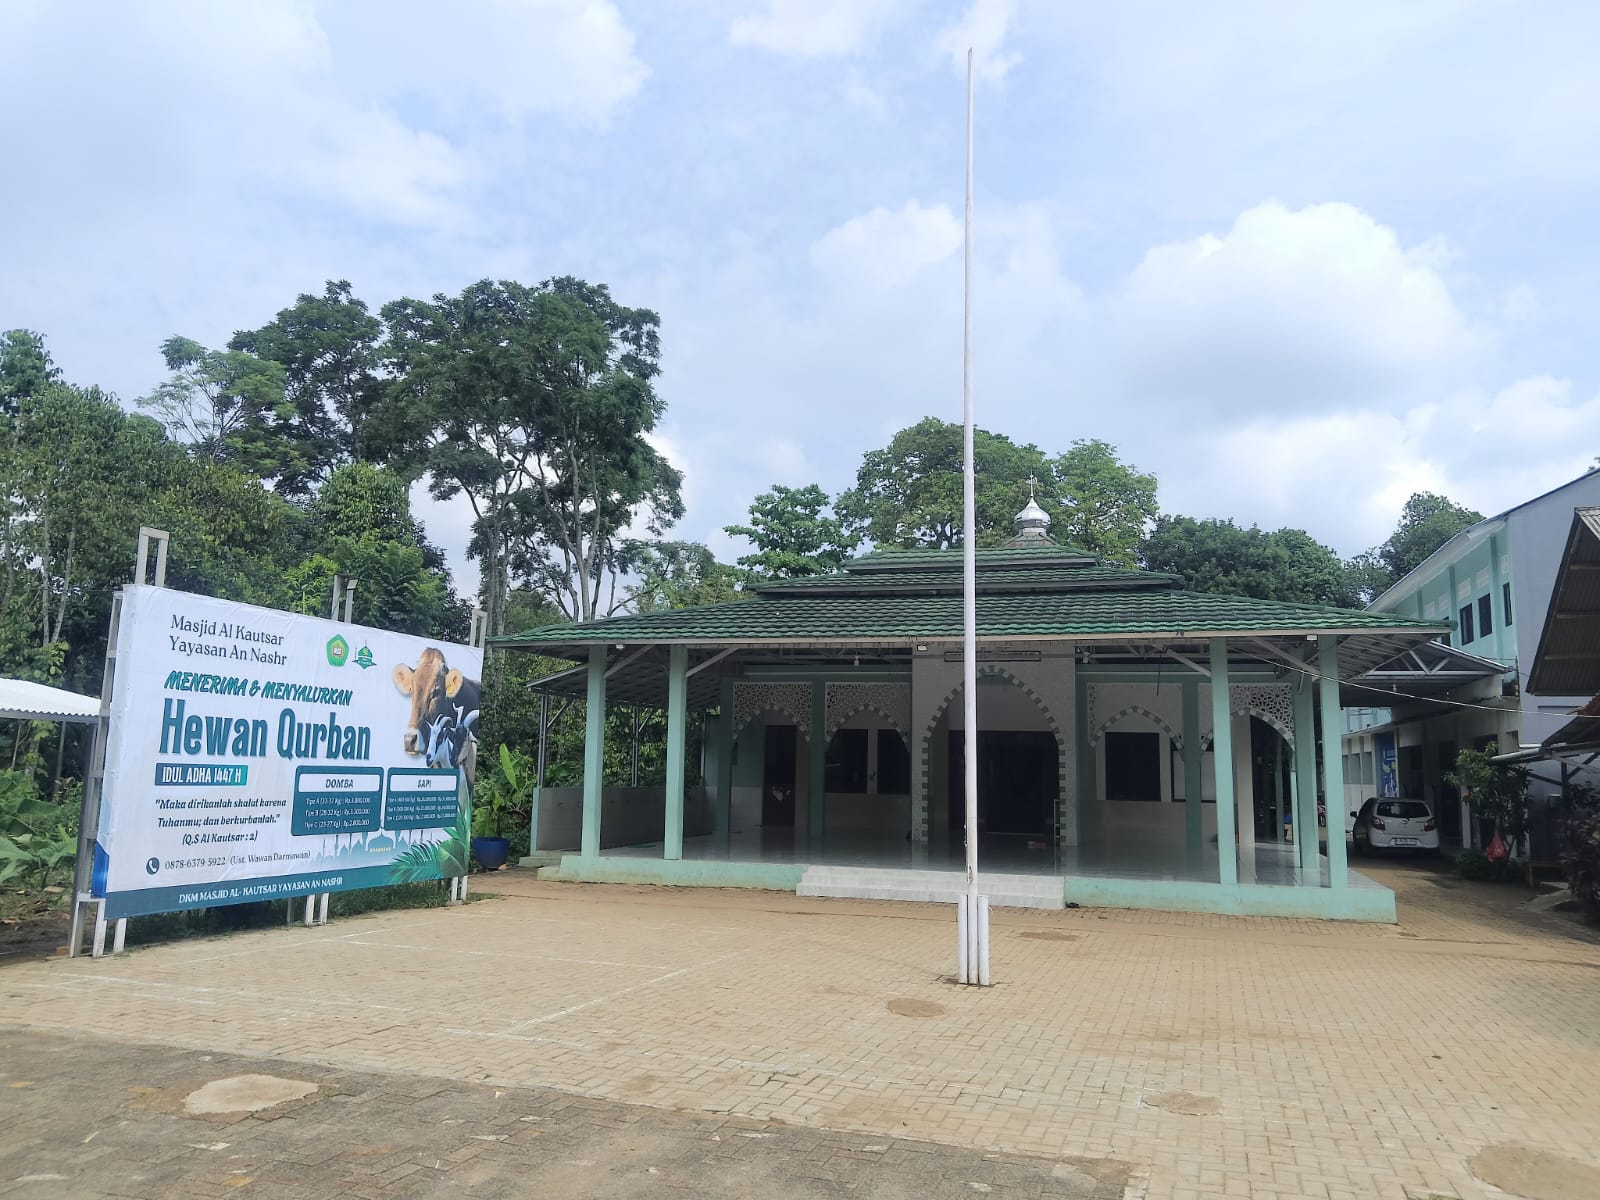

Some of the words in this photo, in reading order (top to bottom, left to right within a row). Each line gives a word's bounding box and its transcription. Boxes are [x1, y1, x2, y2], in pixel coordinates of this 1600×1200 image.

[170, 614, 217, 637] Masjid
[218, 622, 233, 638] Al
[235, 625, 285, 646] Kautsar
[169, 635, 227, 658] Yayasan
[229, 645, 247, 661] An
[250, 647, 287, 666] Nashr
[164, 670, 249, 697] MENERIMA
[249, 679, 261, 697] &
[260, 680, 354, 706] MENYALURKAN
[159, 697, 269, 758] Hewan
[276, 707, 371, 761] Qurban
[162, 766, 184, 783] IDUL
[186, 767, 212, 783] ADHA
[213, 767, 234, 783] 1447
[234, 767, 242, 783] H
[325, 778, 354, 789] DOMBA
[187, 798, 232, 809] dirikanlah
[233, 797, 259, 808] shalat
[259, 797, 287, 808] karena
[203, 816, 220, 826] dan
[200, 833, 210, 844] Al
[211, 832, 245, 843] Kautsar
[178, 892, 199, 904] DKM
[199, 889, 229, 902] MASJID
[242, 884, 277, 896] KAUTSAR
[278, 880, 311, 891] YAYASAN
[310, 880, 321, 888] AN
